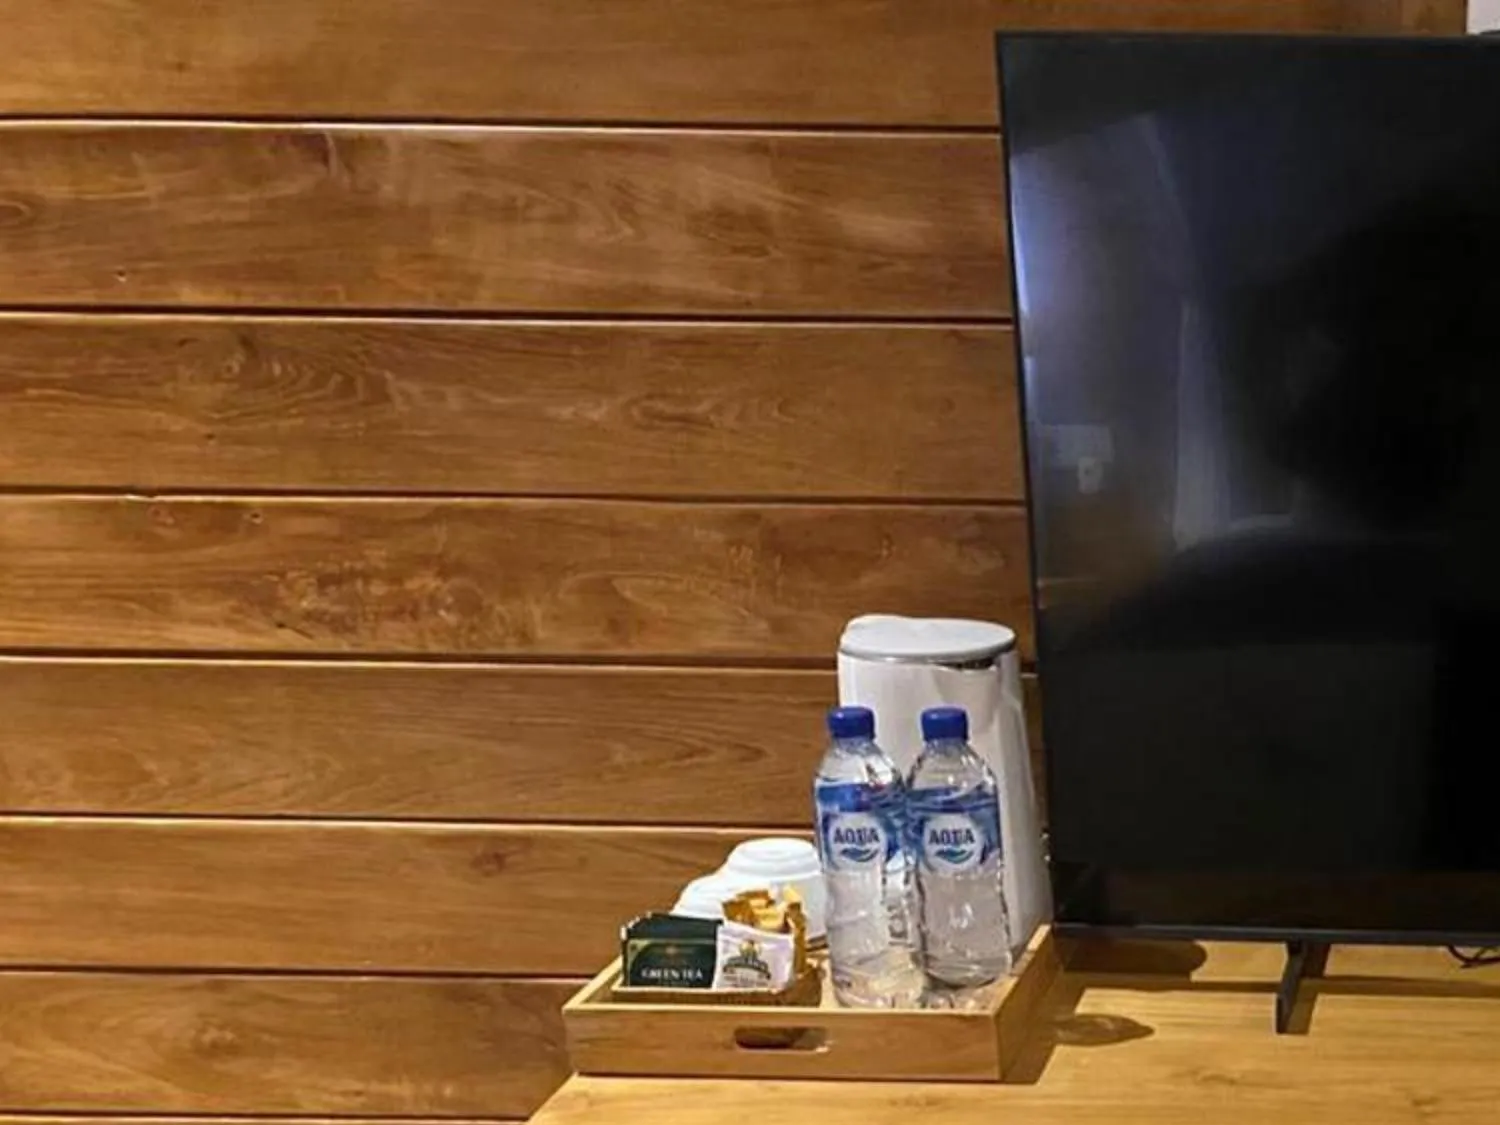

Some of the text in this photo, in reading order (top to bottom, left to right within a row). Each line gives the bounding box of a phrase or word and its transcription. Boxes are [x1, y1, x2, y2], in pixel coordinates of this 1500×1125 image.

[834, 827, 880, 845] AQUA
[928, 828, 975, 846] AQUA
[641, 967, 703, 981] GREEN TEA
